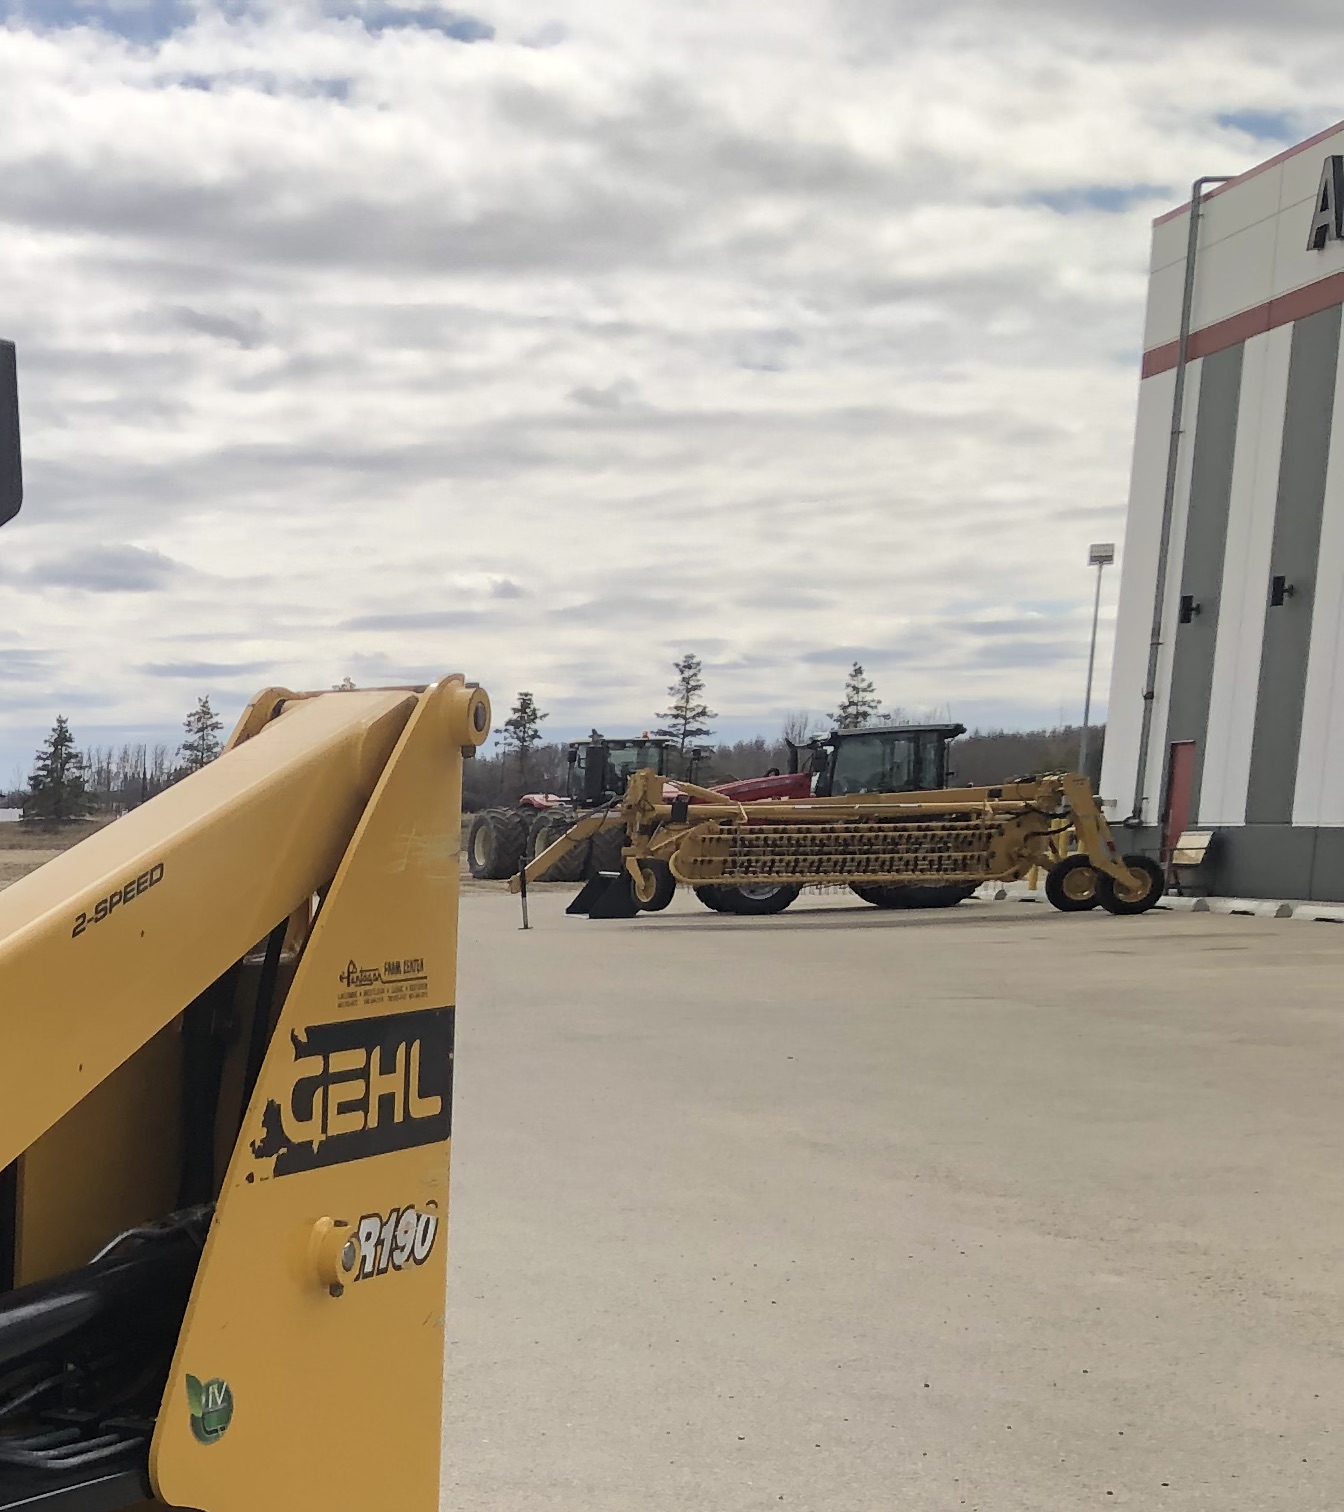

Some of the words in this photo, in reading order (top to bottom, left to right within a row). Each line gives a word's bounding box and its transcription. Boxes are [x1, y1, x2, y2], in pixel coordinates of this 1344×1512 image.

[71, 862, 165, 939] 2-SPEED
[279, 1038, 443, 1146] GEHL
[352, 1199, 440, 1282] R190
